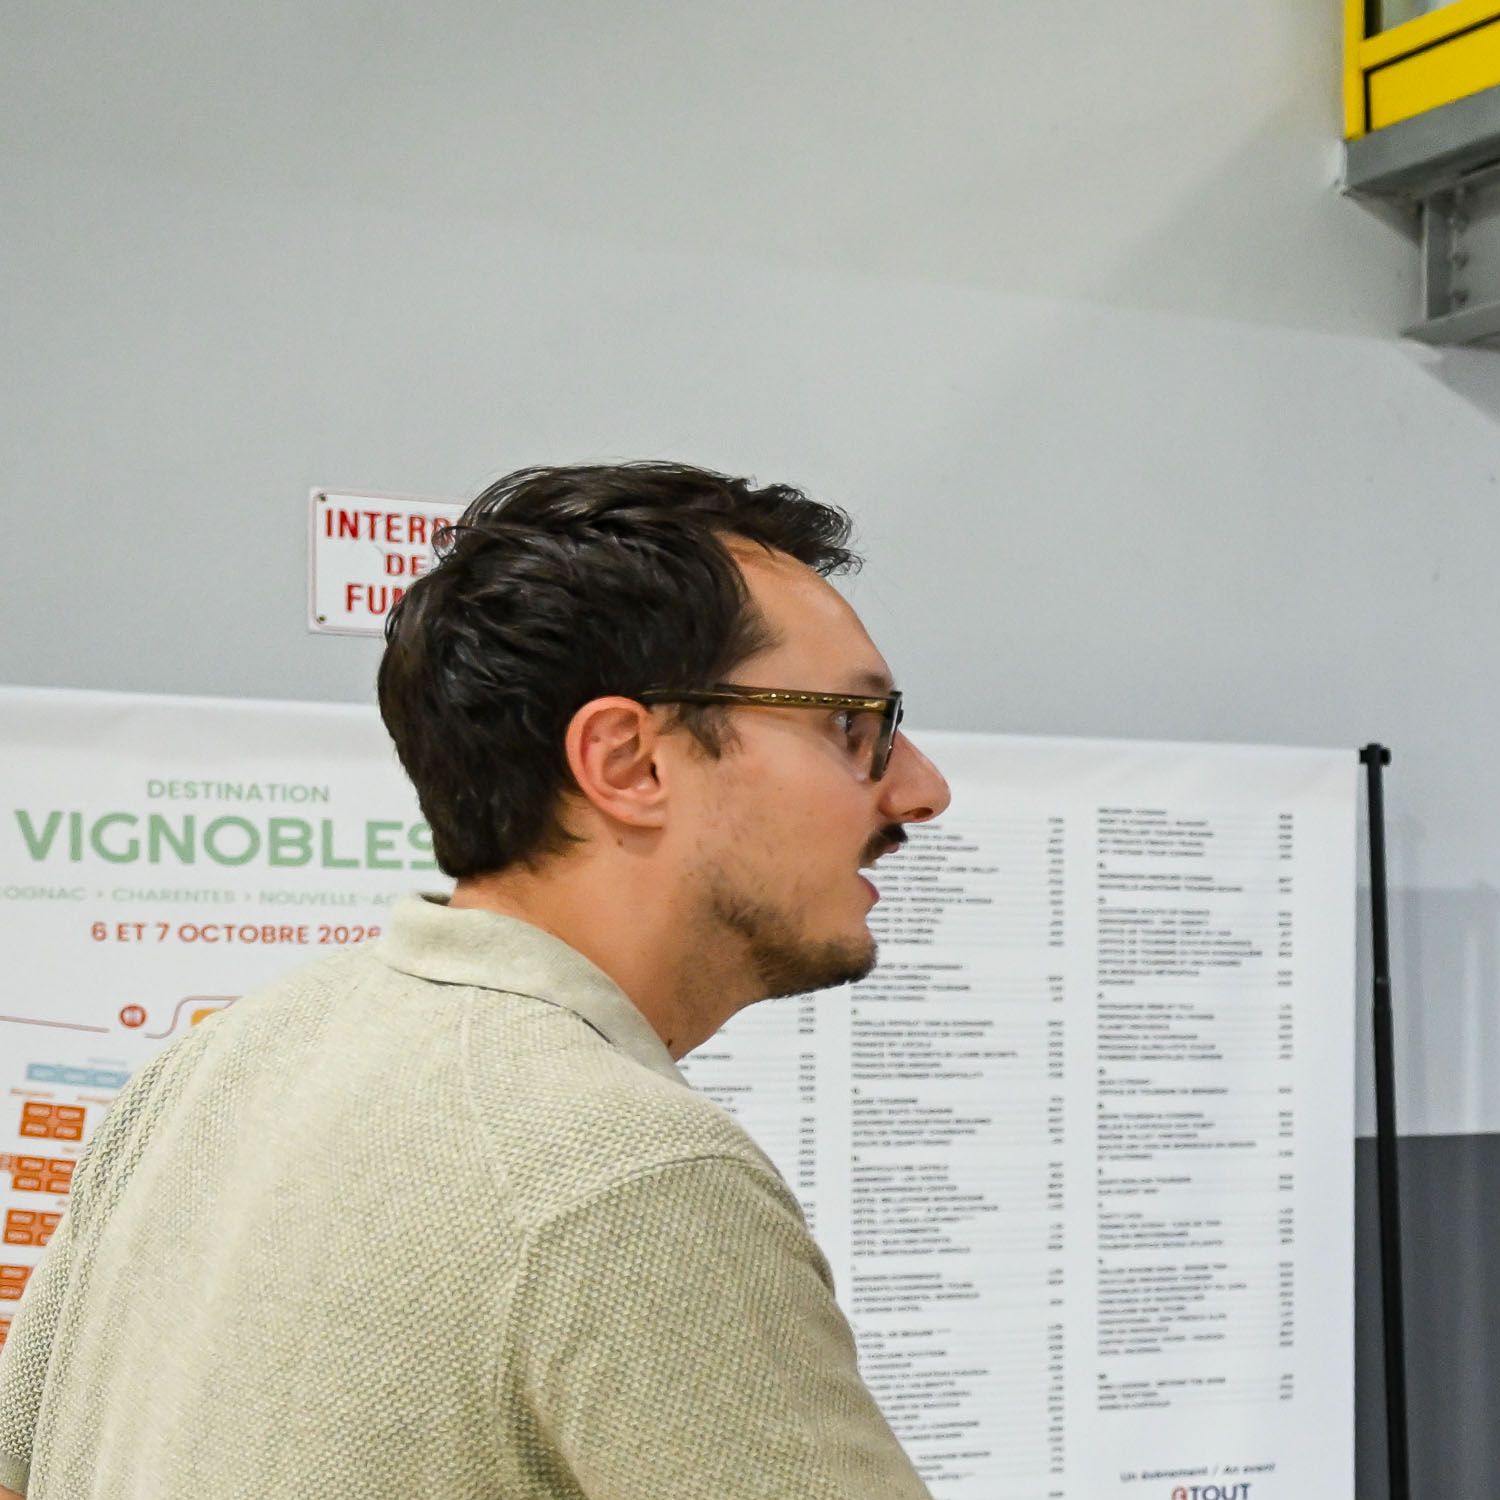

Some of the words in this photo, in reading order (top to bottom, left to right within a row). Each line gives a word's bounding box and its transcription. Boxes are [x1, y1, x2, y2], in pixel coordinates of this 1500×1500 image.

[325, 508, 456, 547] INTERD
[146, 779, 329, 804] DESTINATION
[3, 885, 86, 901] OGNAC
[91, 921, 107, 942] 6
[116, 921, 146, 942] ET
[156, 922, 170, 942] 7
[177, 922, 309, 944] OCTOBRE
